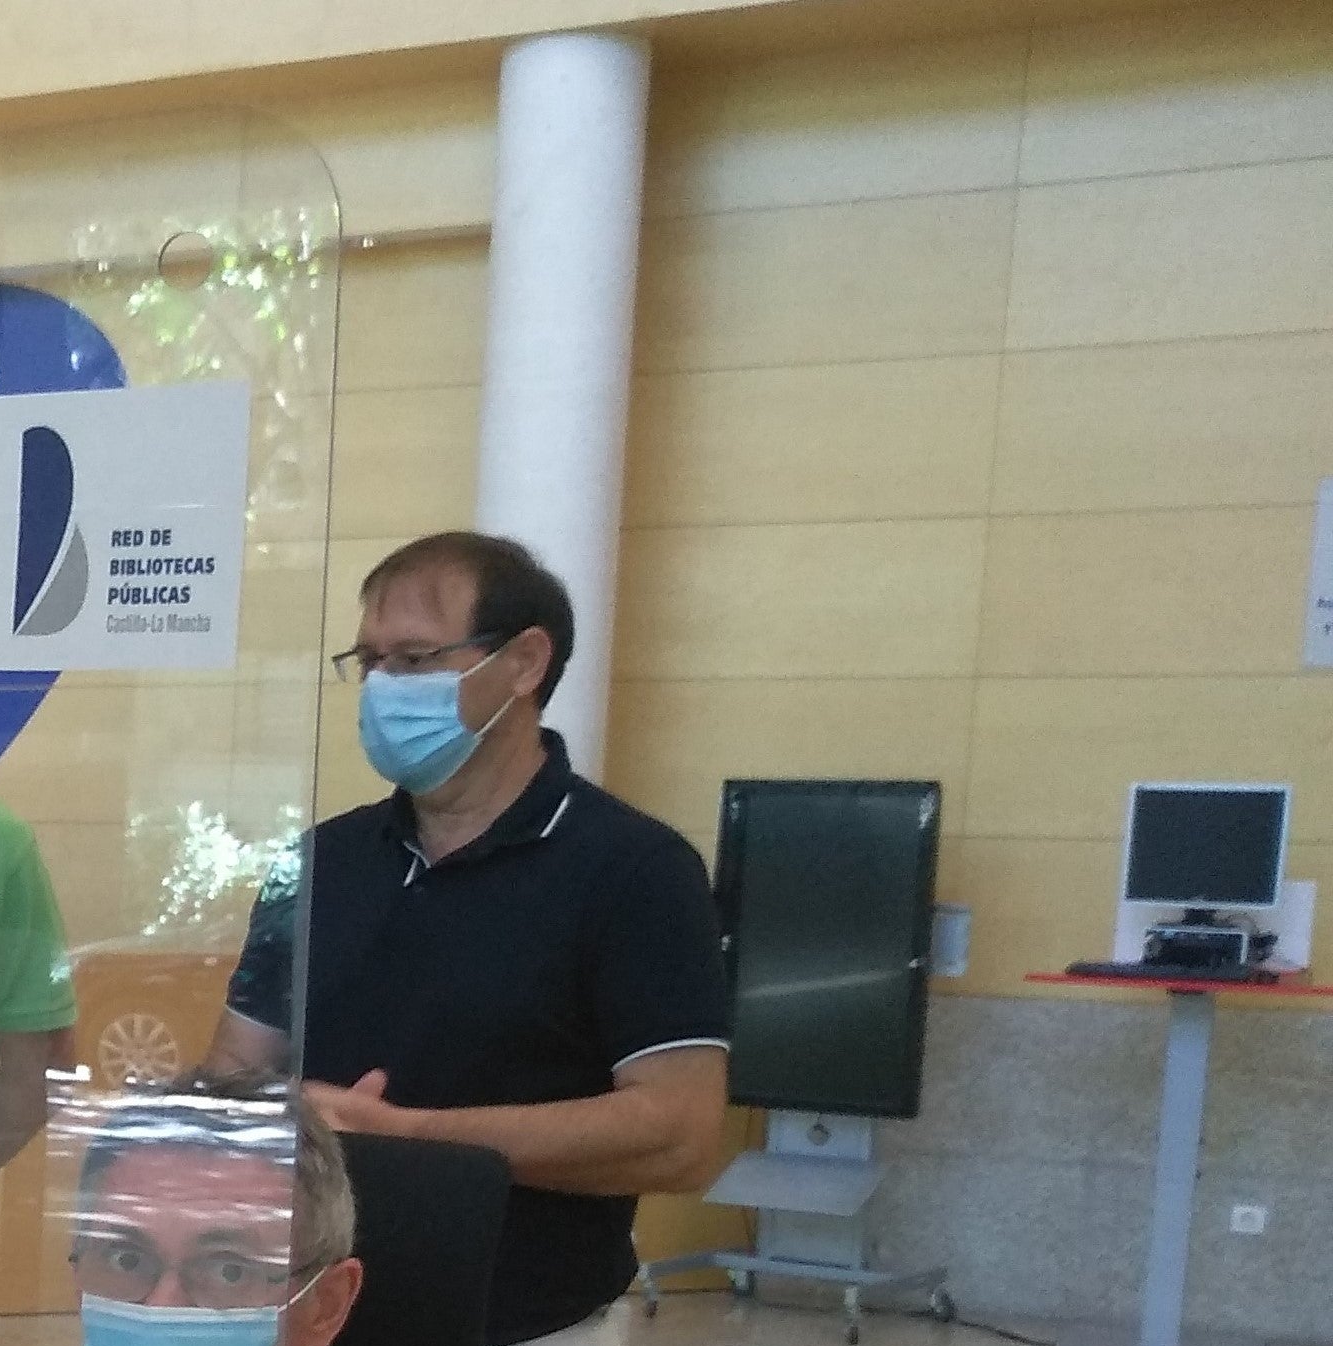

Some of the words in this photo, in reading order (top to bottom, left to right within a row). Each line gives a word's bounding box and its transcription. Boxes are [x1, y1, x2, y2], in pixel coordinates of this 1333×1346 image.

[111, 529, 144, 547] RED
[150, 529, 172, 546] DE
[109, 557, 215, 576] BIBLIOTECAS
[107, 583, 191, 605] PÚBLICAS
